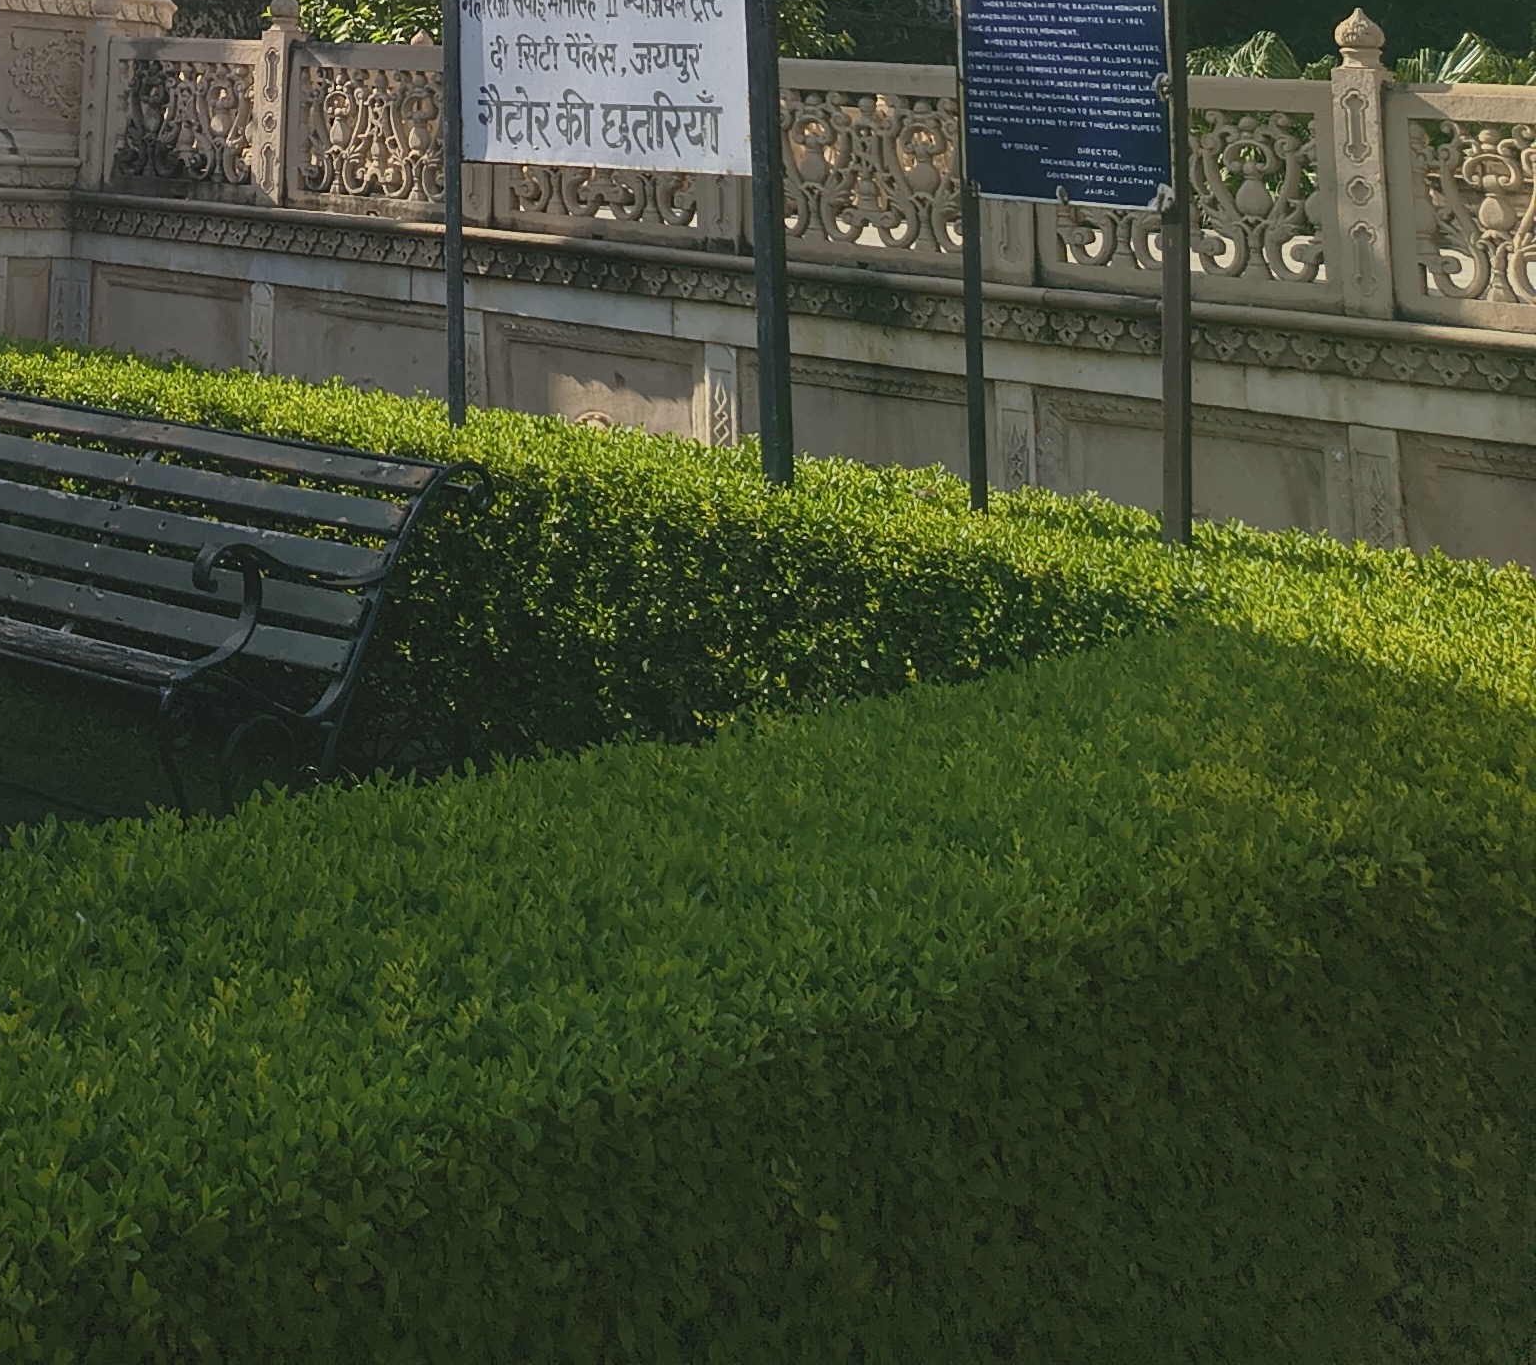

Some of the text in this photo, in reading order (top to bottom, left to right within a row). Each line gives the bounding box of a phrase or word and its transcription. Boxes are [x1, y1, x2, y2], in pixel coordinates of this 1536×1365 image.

[490, 35, 508, 75] दी
[516, 33, 560, 73] सिटी
[630, 42, 703, 84] जयपुर
[556, 88, 594, 147] की
